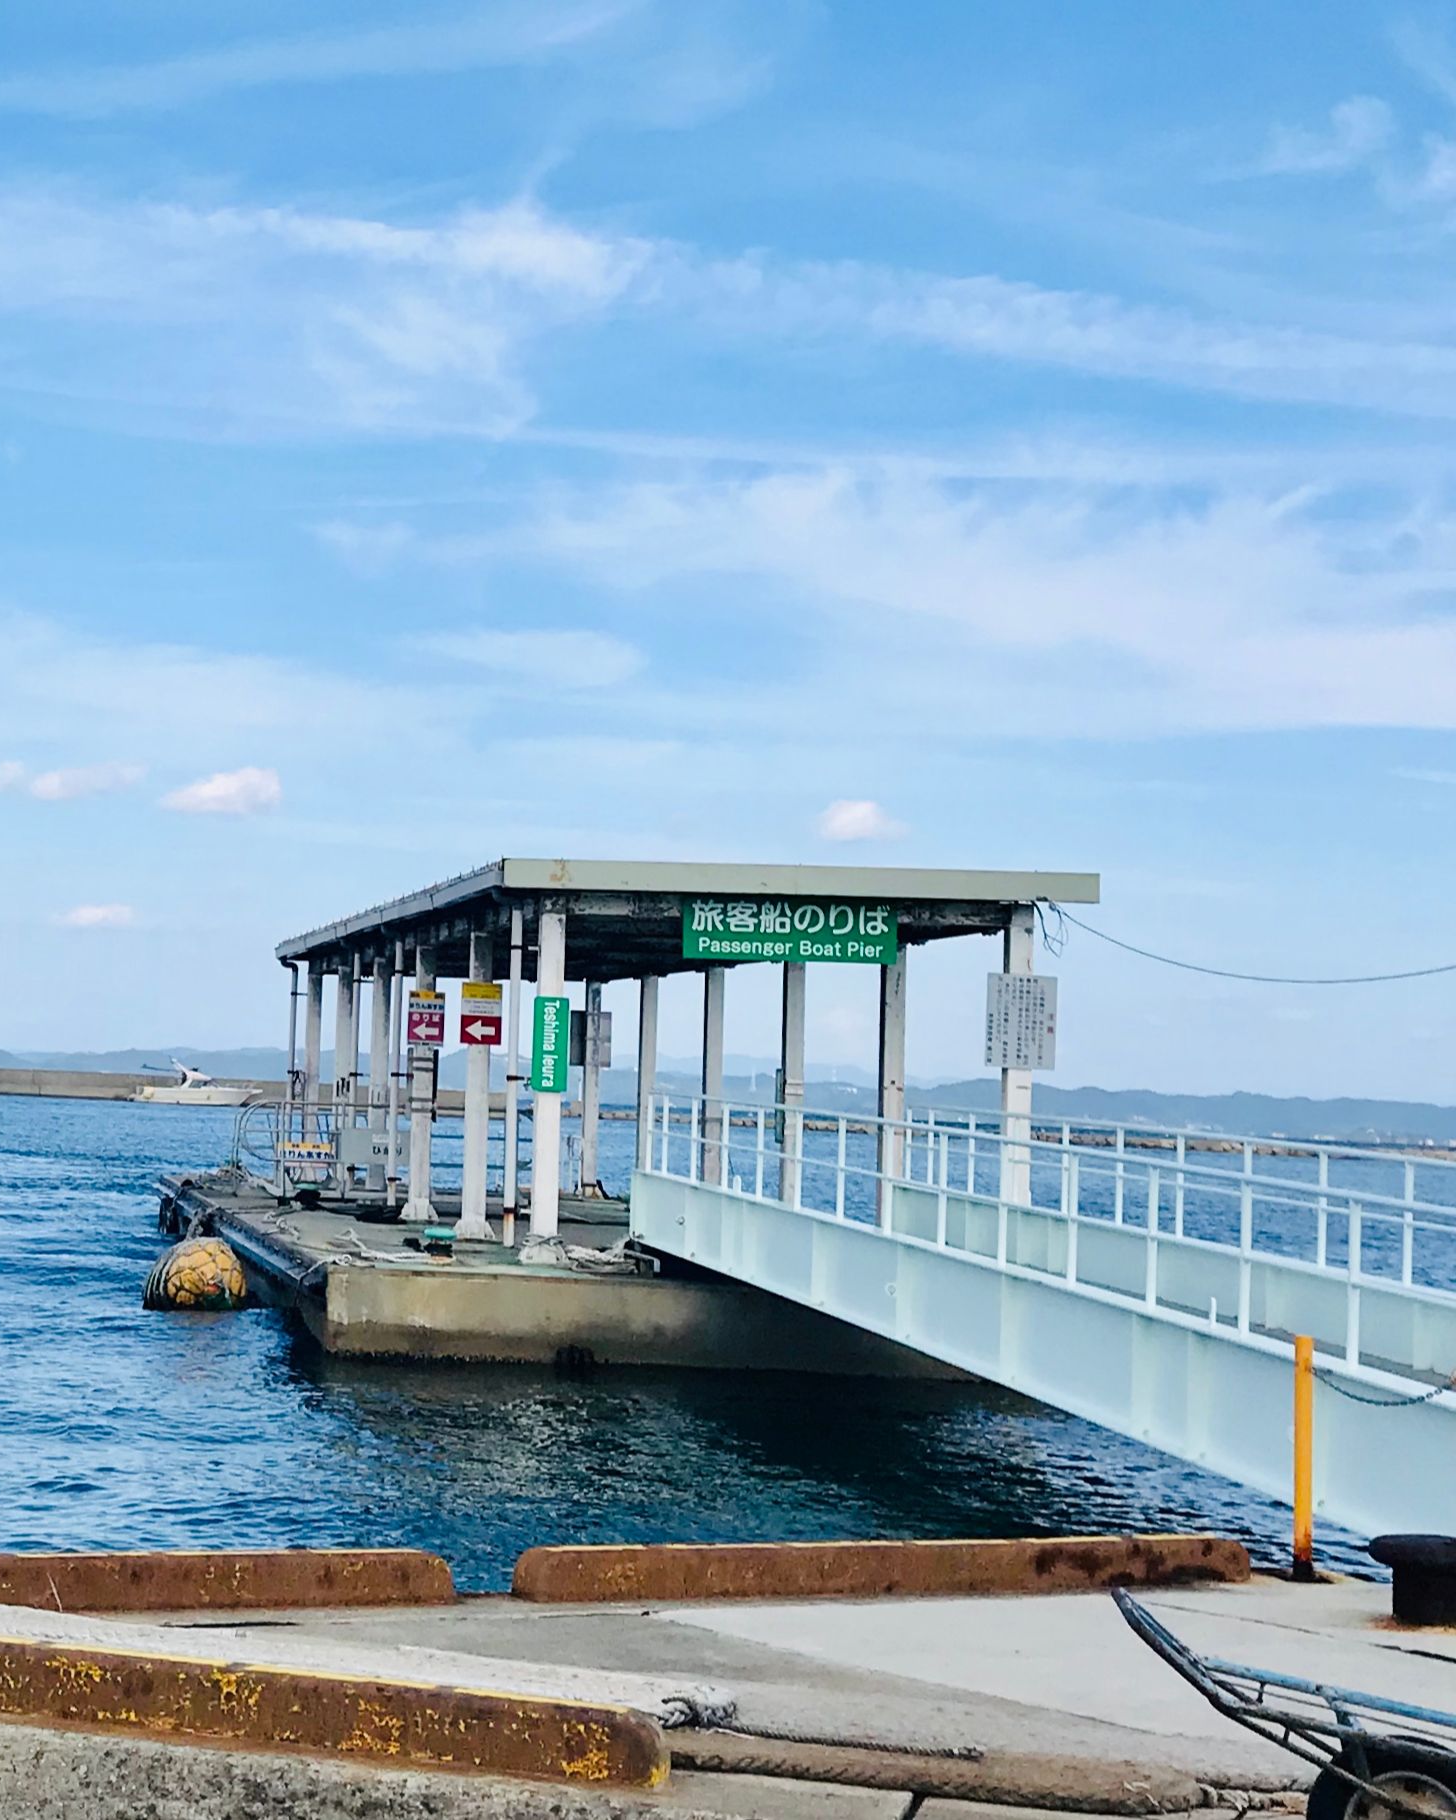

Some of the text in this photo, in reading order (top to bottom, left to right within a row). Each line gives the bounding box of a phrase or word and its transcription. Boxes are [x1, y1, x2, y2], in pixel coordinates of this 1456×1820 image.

[691, 900, 890, 935] 旅客船のりば
[698, 937, 884, 958] Passenger Boat Pier
[542, 1000, 560, 1051] Teshima
